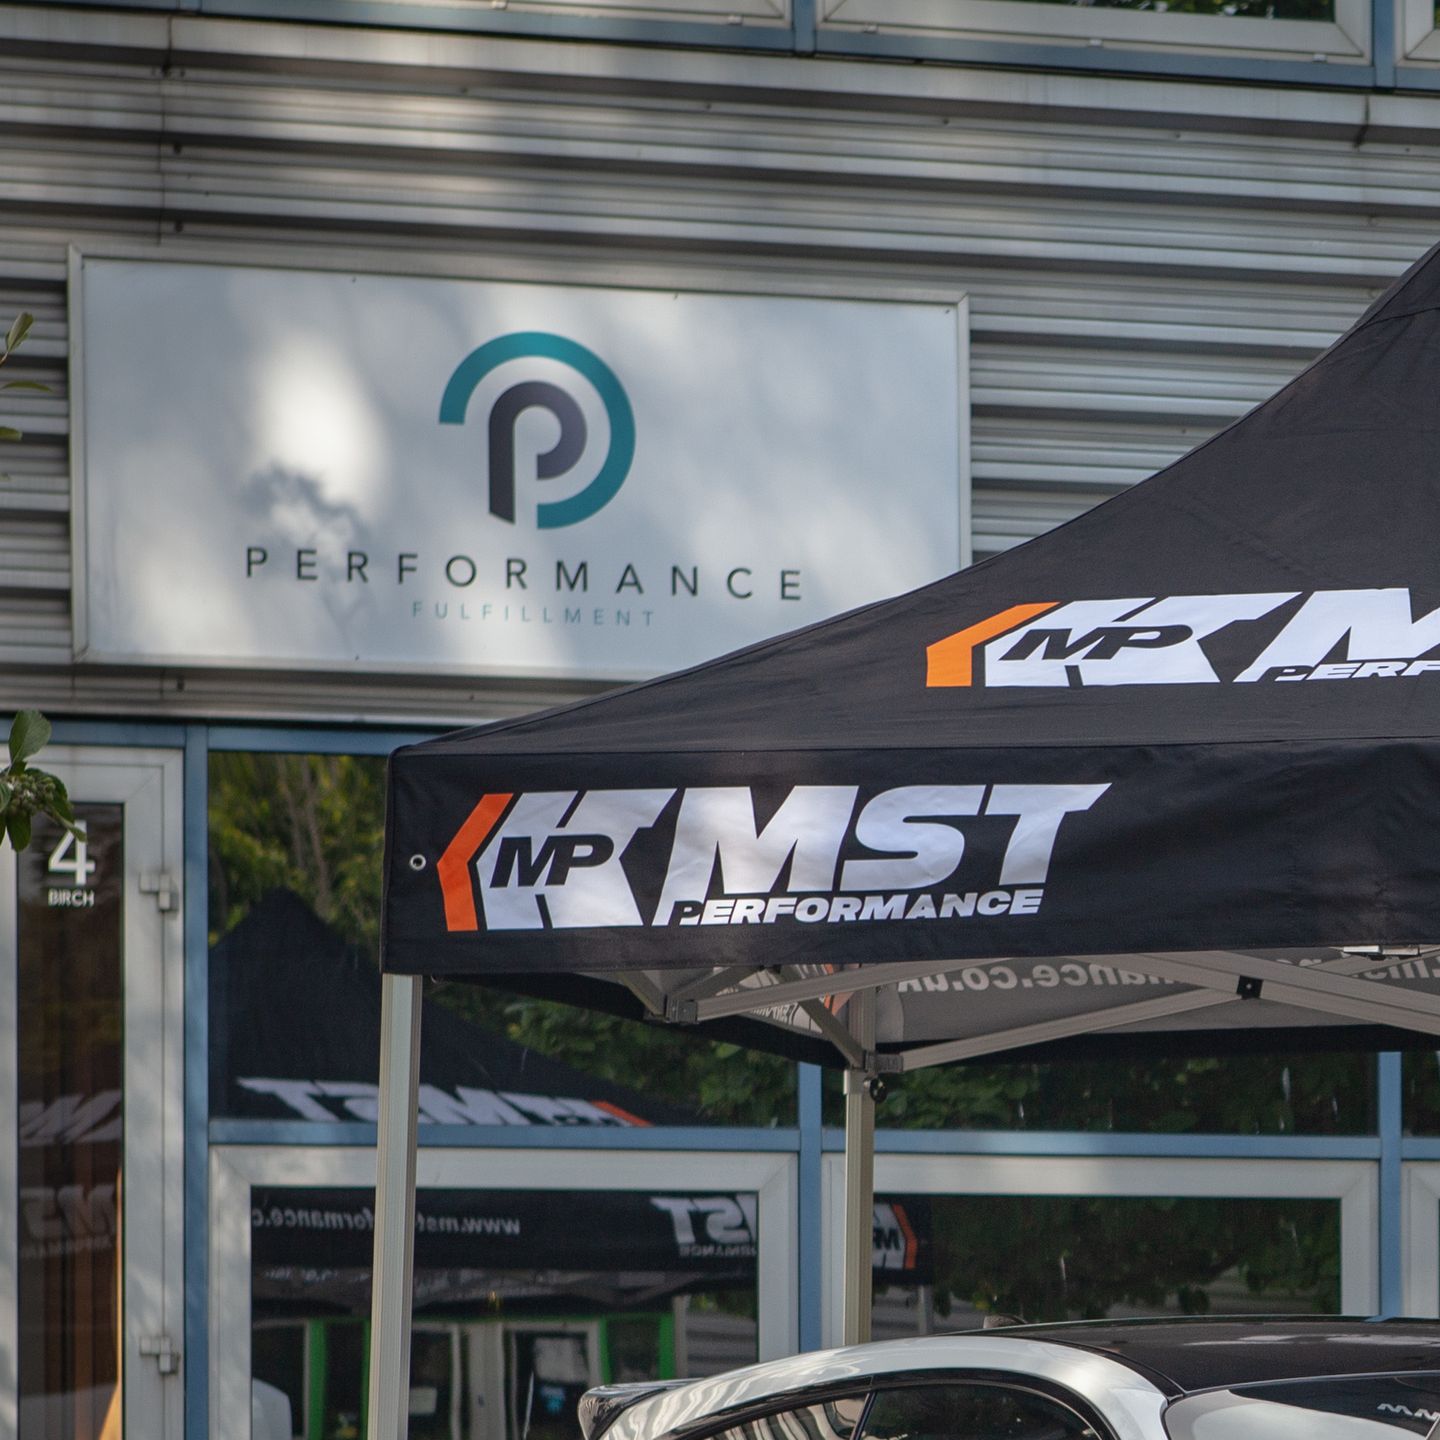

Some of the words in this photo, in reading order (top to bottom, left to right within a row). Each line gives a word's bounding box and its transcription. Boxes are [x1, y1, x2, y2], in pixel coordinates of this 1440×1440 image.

[246, 546, 803, 601] PERFORMANCE
[411, 601, 655, 627] FULFILLMENT
[48, 820, 95, 886] 4
[652, 783, 1111, 926] MST
[48, 888, 95, 907] BIRCH
[680, 889, 1043, 926] PERFORMANCE
